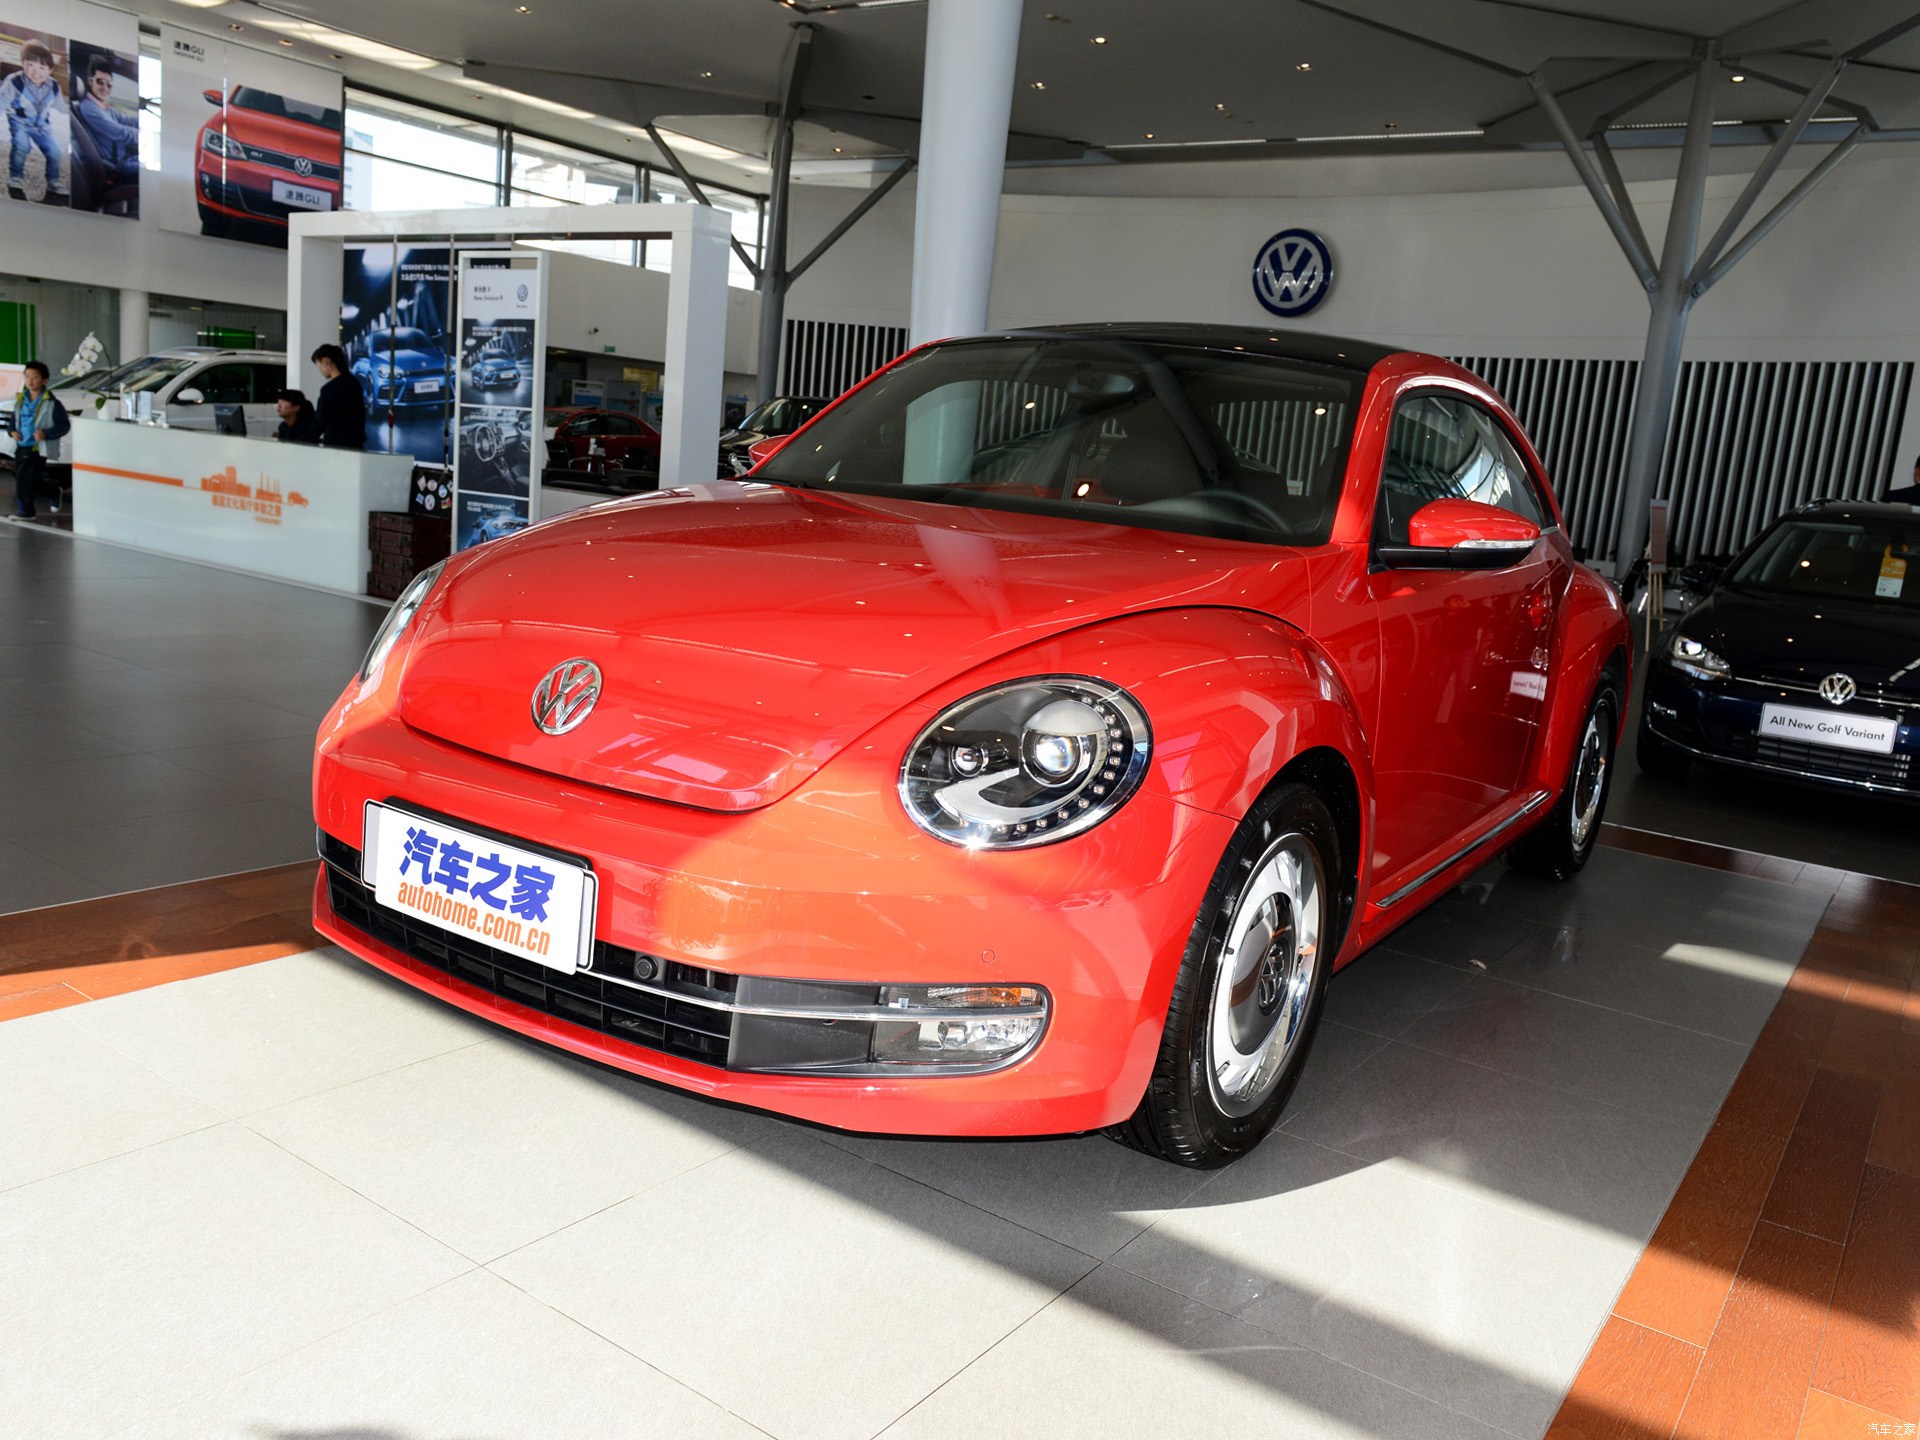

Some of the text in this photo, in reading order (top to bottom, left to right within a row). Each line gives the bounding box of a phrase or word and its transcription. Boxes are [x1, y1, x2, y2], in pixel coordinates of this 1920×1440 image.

[1770, 715, 1885, 741] All New Golf Variant
[399, 826, 555, 923] 汽车之家
[398, 881, 551, 956] autohome.com.cn
